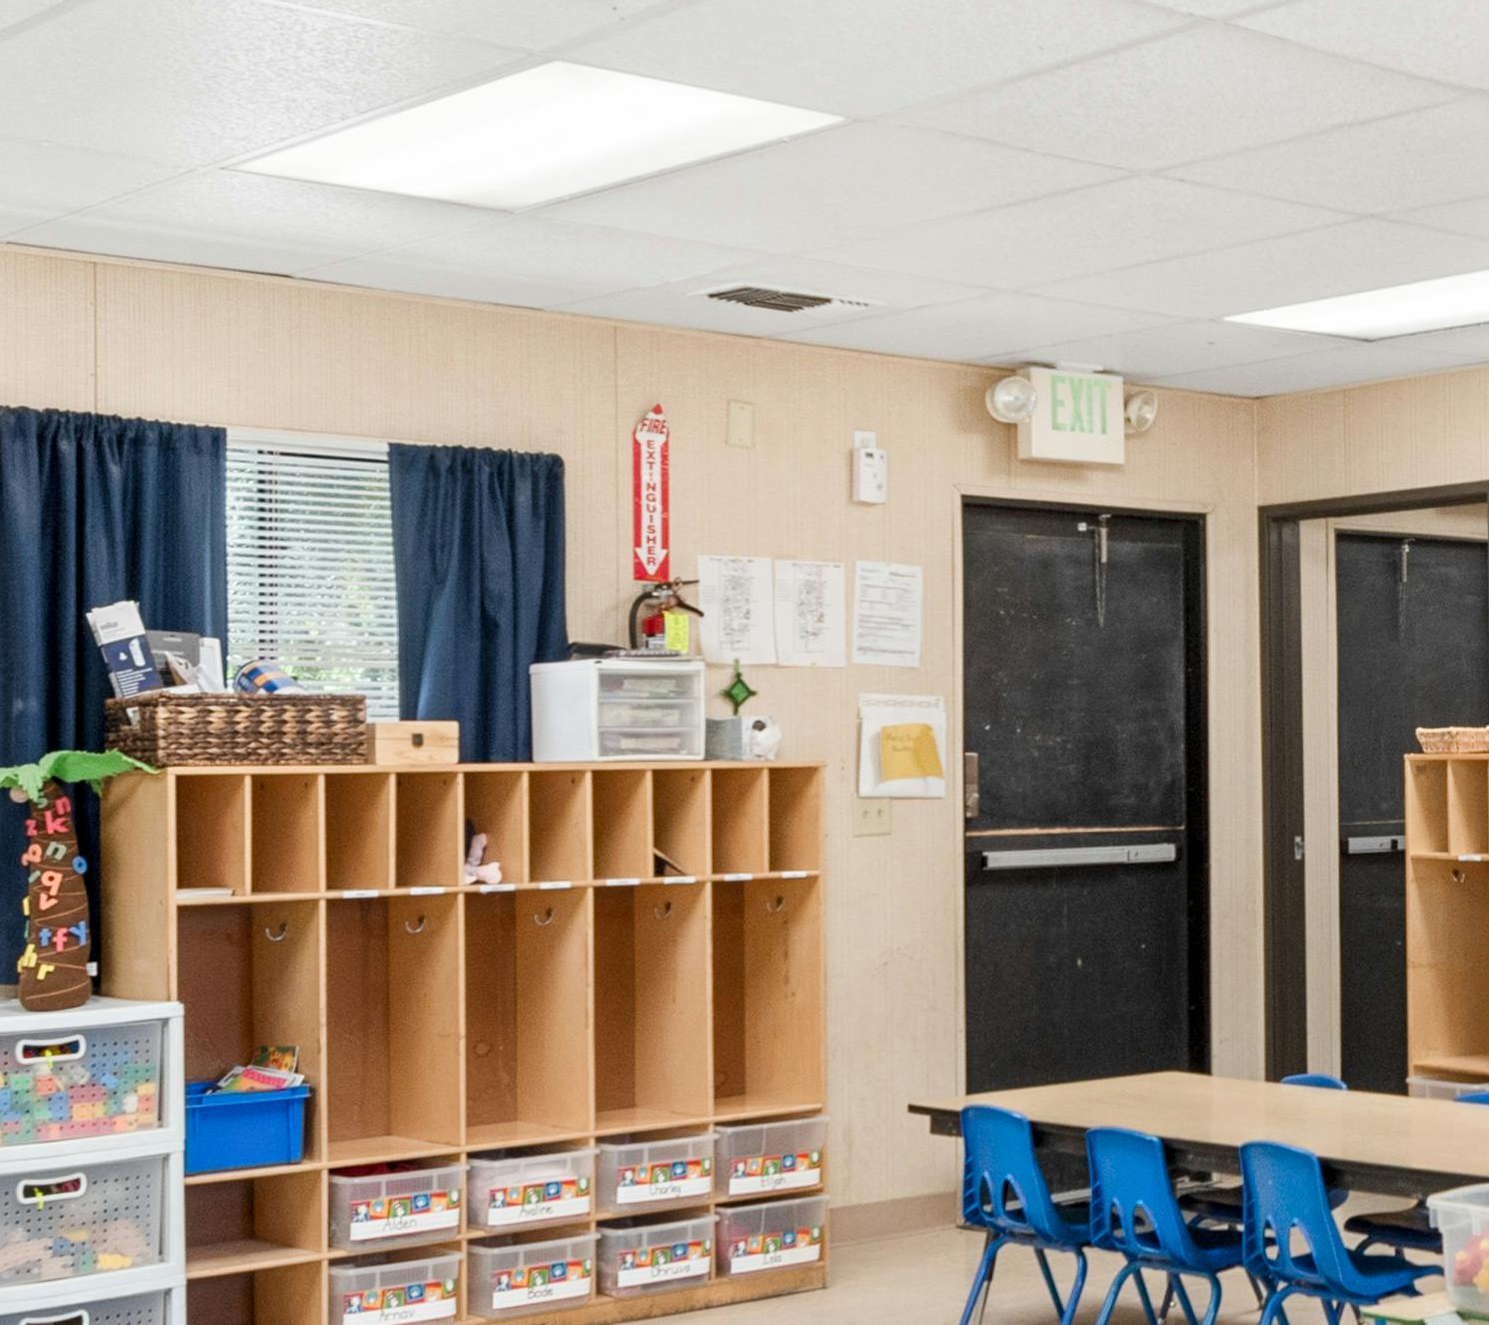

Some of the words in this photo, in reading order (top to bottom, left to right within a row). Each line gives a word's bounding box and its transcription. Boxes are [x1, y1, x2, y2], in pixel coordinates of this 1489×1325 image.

[639, 417, 668, 435] FIRE
[1050, 374, 1111, 435] EXIT
[646, 440, 657, 566] EXTINGUISHER
